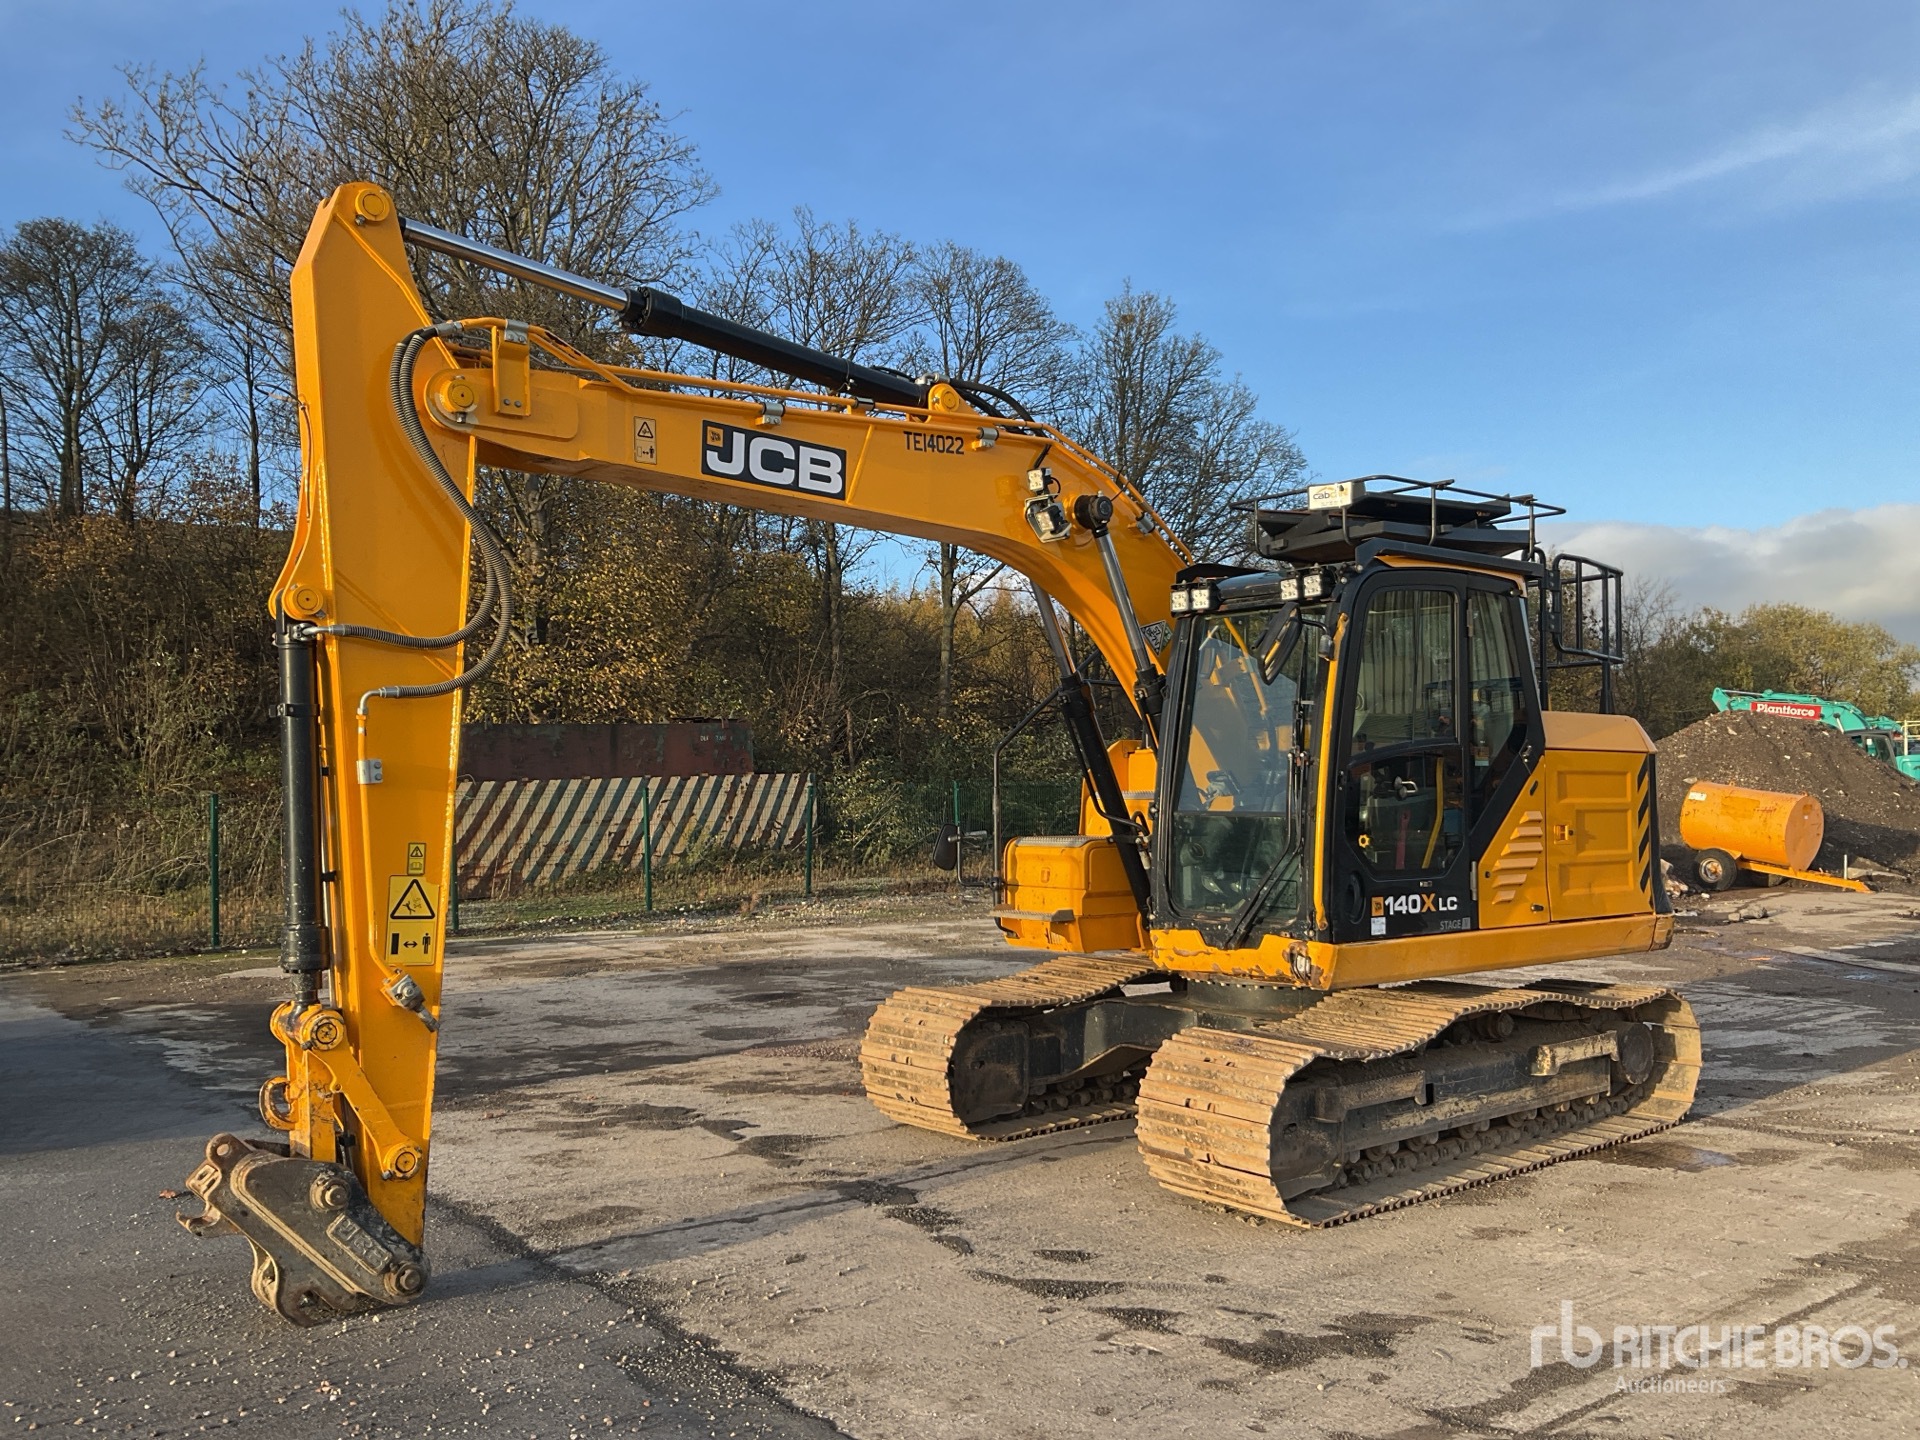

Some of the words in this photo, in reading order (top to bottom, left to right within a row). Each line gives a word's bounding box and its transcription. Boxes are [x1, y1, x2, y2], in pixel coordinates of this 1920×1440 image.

[903, 430, 964, 455] TE14022
[706, 431, 843, 494] JCB
[1756, 703, 1815, 717] Plantforce
[1439, 896, 1458, 911] LC
[1440, 920, 1461, 931] STAGE
